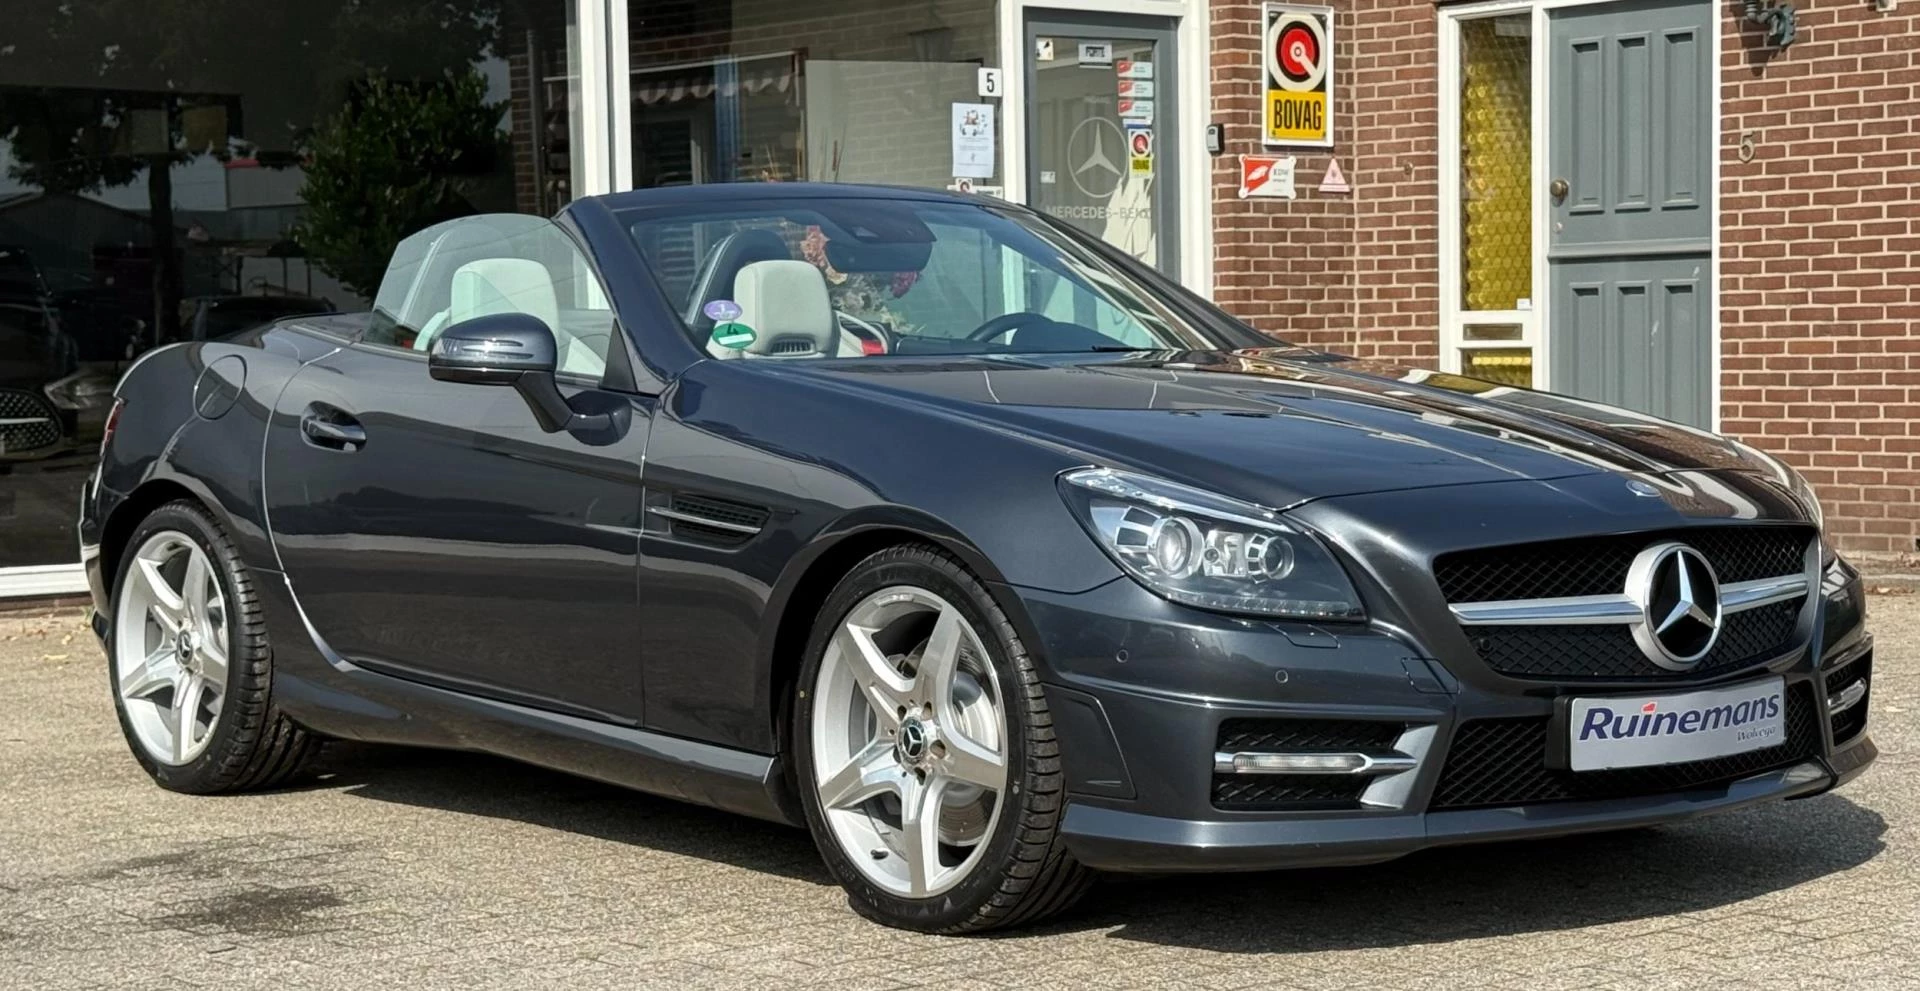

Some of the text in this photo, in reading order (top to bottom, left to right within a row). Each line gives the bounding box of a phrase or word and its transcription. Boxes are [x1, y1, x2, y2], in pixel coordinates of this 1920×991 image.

[986, 72, 995, 93] 5
[1274, 99, 1321, 131] BOVAG
[1738, 130, 1755, 163] 5
[1579, 694, 1780, 741] Ruinemans
